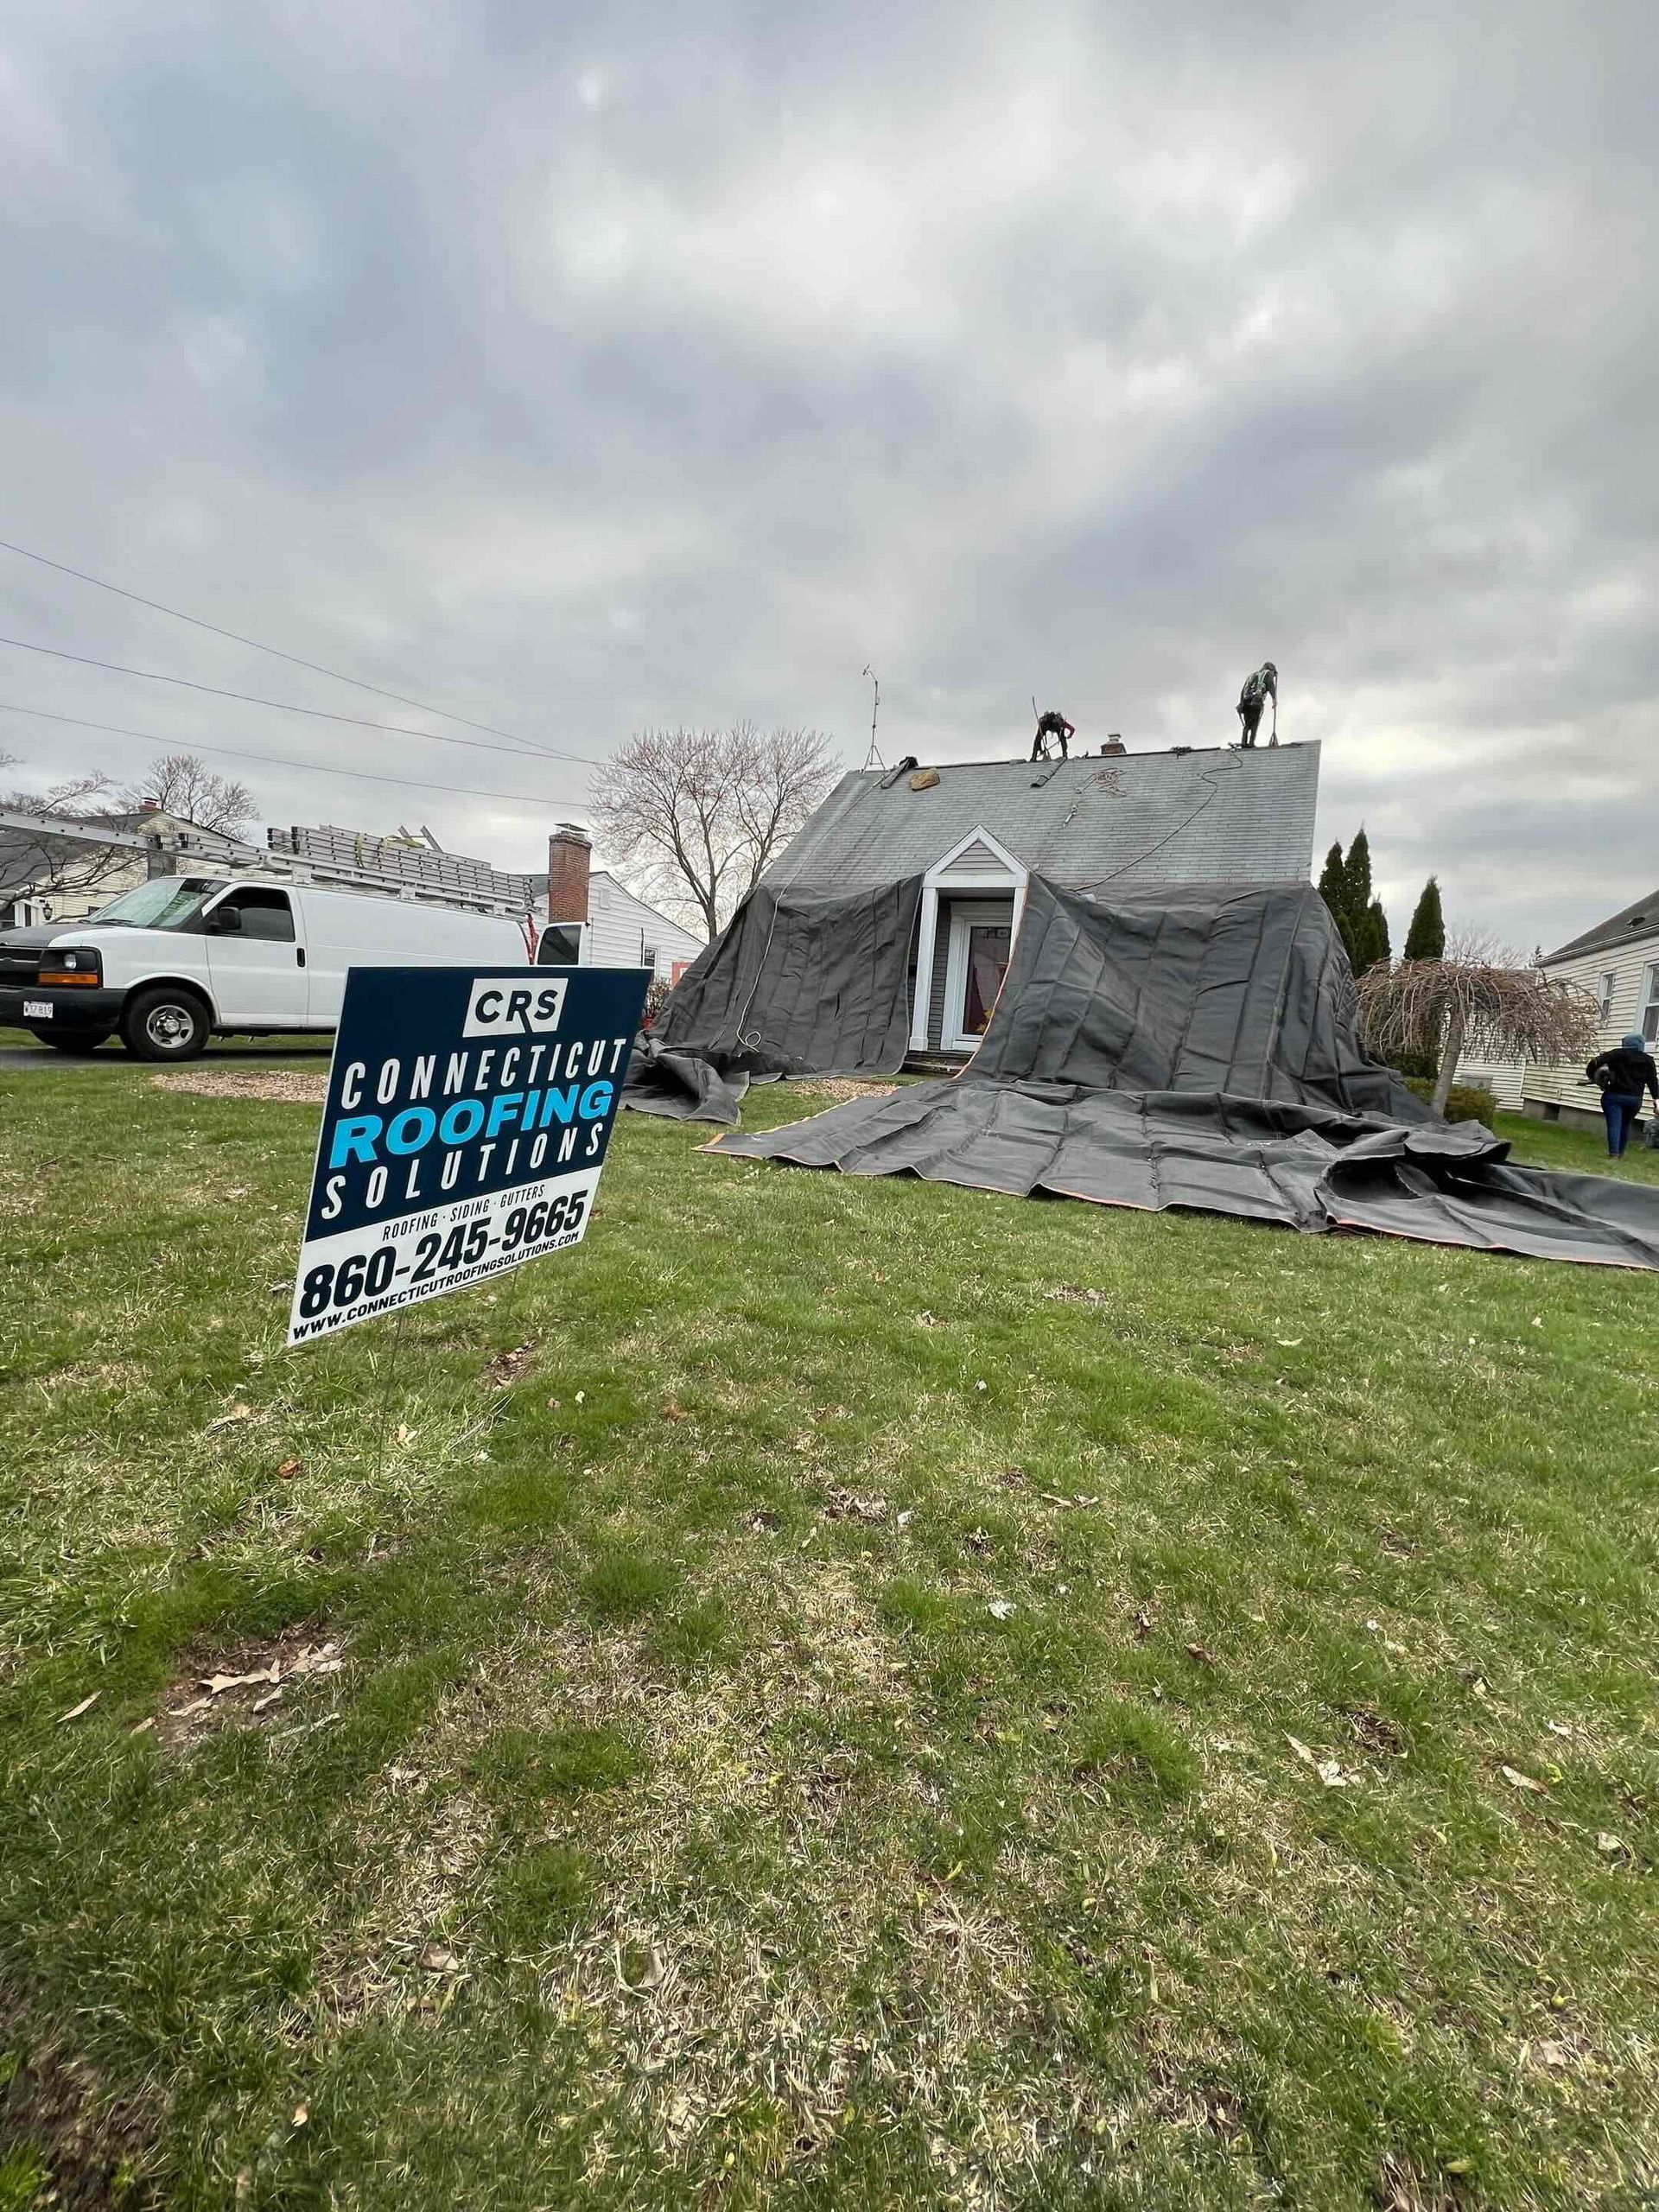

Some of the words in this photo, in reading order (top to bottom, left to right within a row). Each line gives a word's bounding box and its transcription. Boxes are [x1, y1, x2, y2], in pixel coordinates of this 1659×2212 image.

[475, 989, 558, 1033] CRS
[340, 1039, 626, 1109] CONNECTICUT
[328, 1081, 613, 1169] ROOFING
[321, 1122, 604, 1220] SOLUTIONS
[383, 1212, 438, 1242] ROOFING
[450, 1198, 490, 1222] SIDING
[500, 1184, 545, 1208] GUTTERS
[293, 1231, 580, 1340] WWW.CONNECTICUTROOFINGSOLUTIONS.COM
[300, 1190, 588, 1319] 860-245-9665
